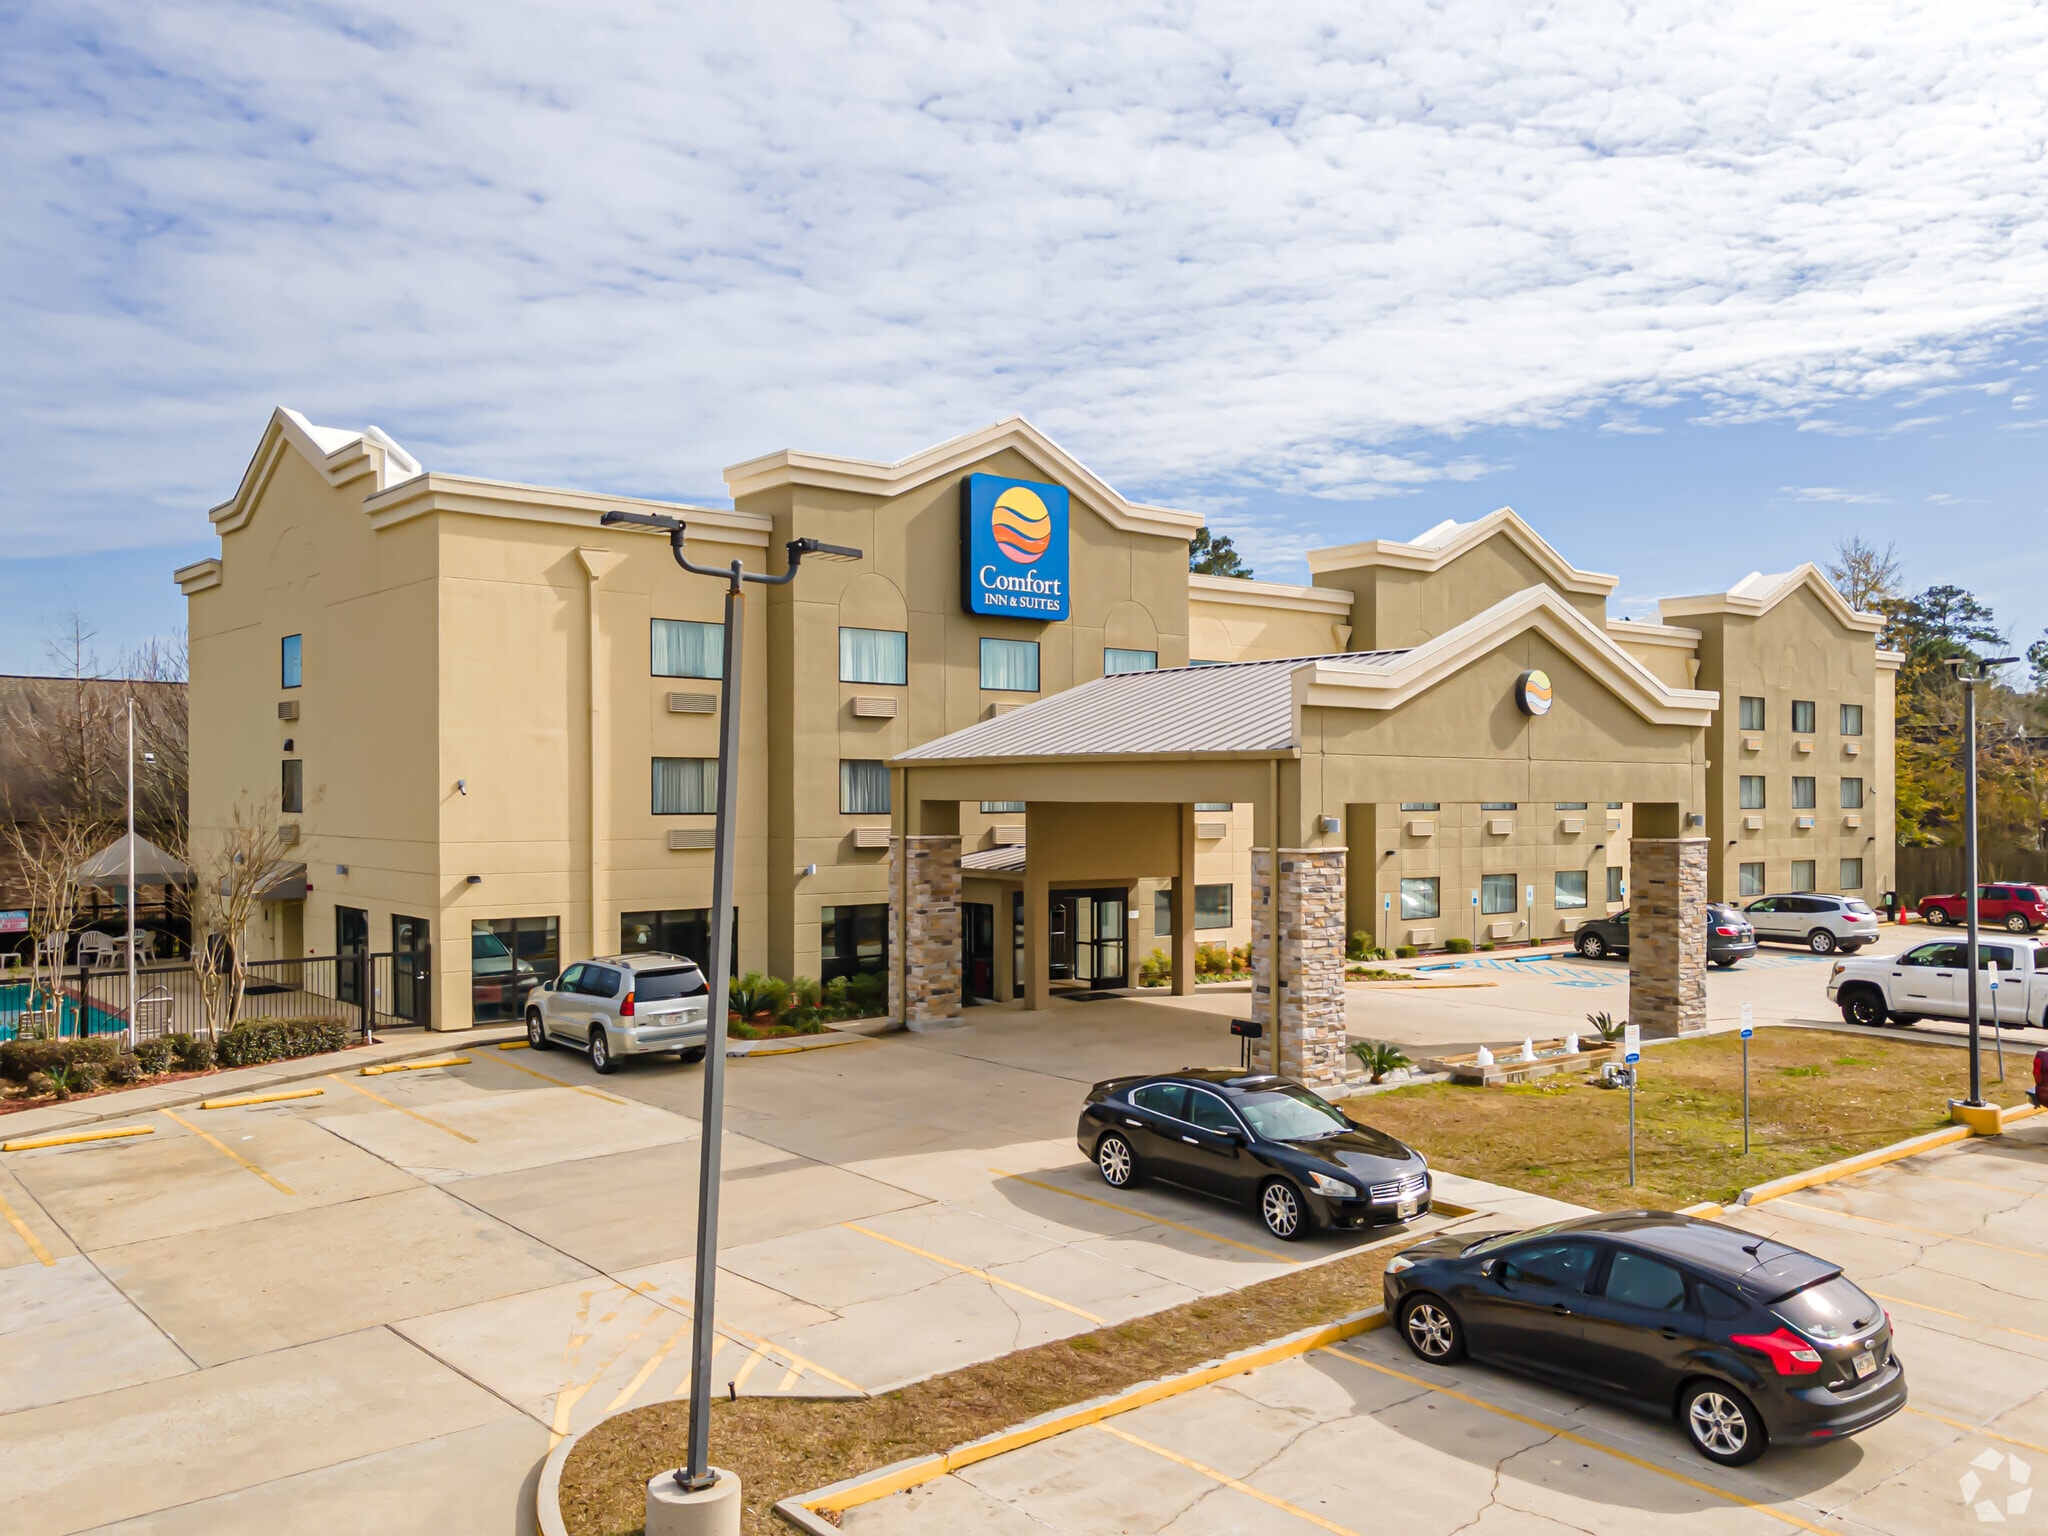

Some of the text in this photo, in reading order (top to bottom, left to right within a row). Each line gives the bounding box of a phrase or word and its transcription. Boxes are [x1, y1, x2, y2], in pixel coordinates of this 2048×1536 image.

[980, 565, 1061, 595] Comfort
[985, 593, 1060, 611] INN & SUITES
